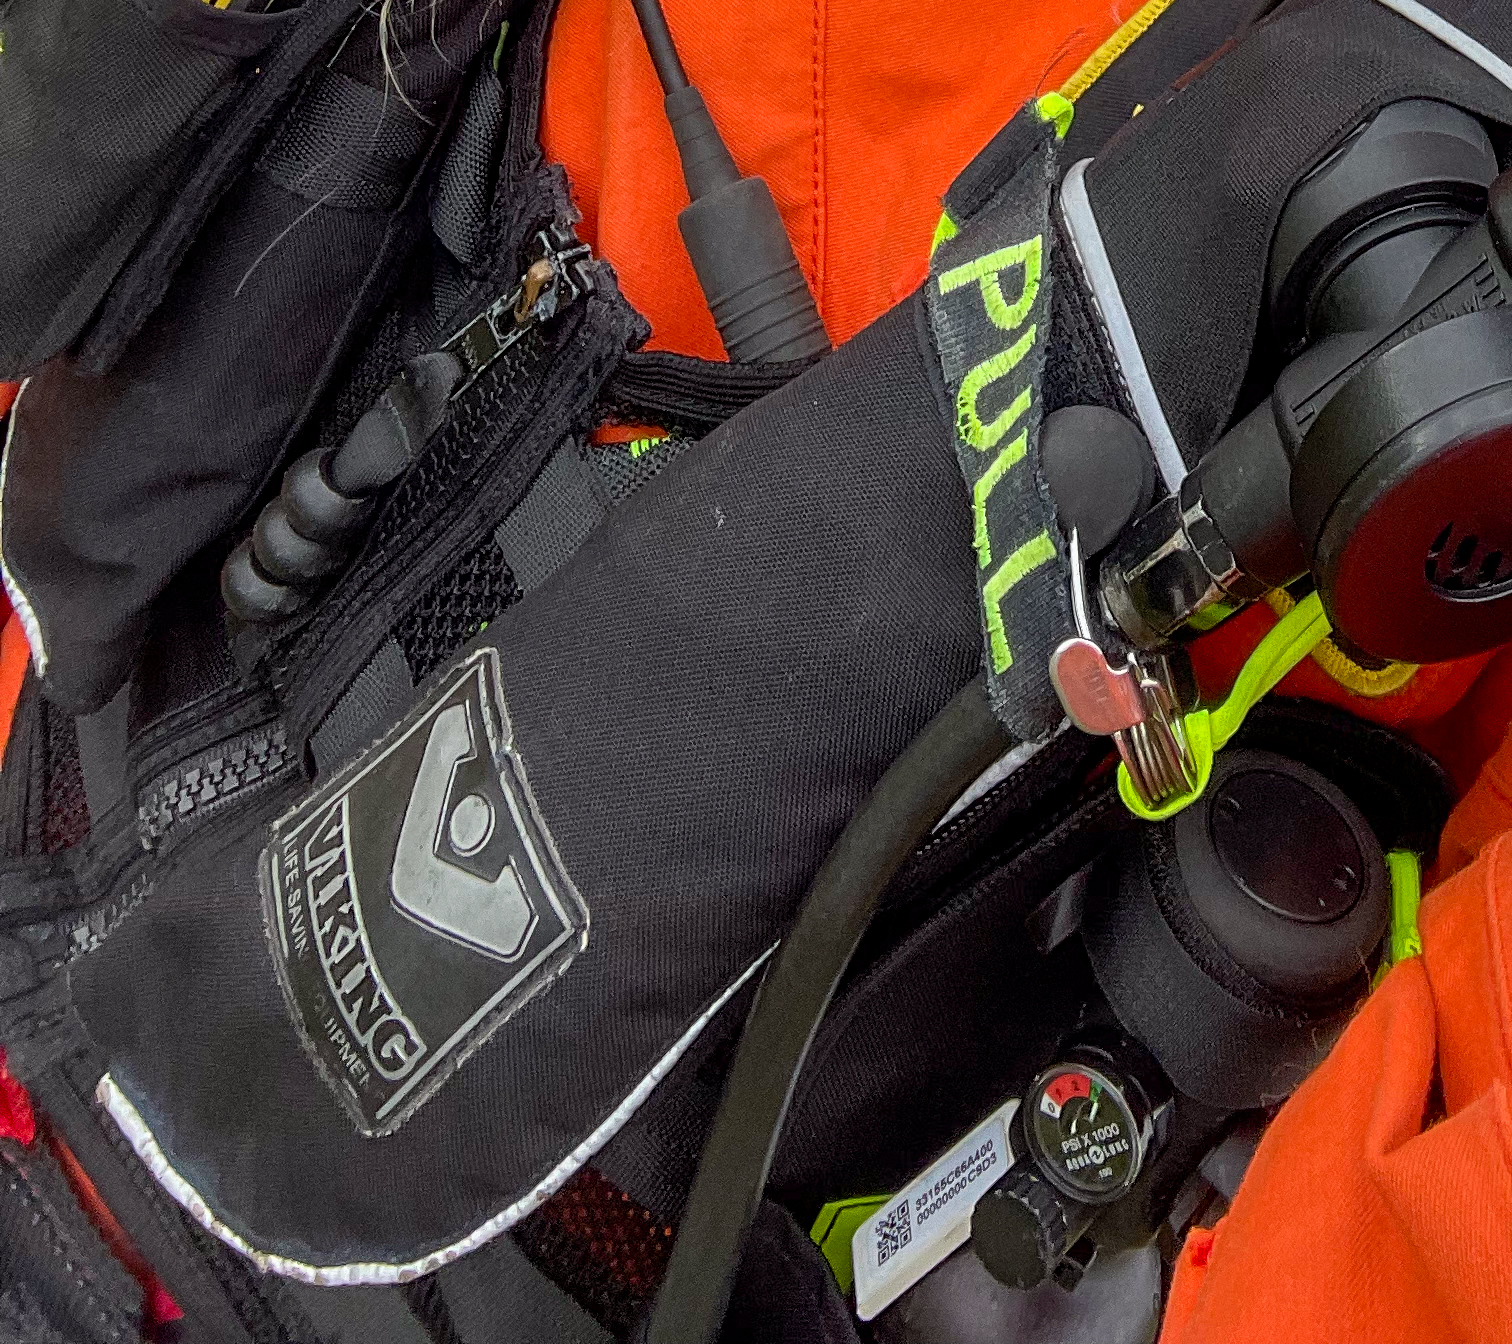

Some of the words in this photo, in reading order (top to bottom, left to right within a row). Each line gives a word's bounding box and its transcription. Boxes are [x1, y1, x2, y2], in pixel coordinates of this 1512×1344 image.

[938, 233, 1057, 675] PULL
[283, 836, 310, 958] LIFE-SAVIN
[304, 793, 427, 1081] VIKING
[1061, 1136, 1082, 1154] PSI
[1080, 1132, 1092, 1148] X
[1091, 1122, 1120, 1142] 1000
